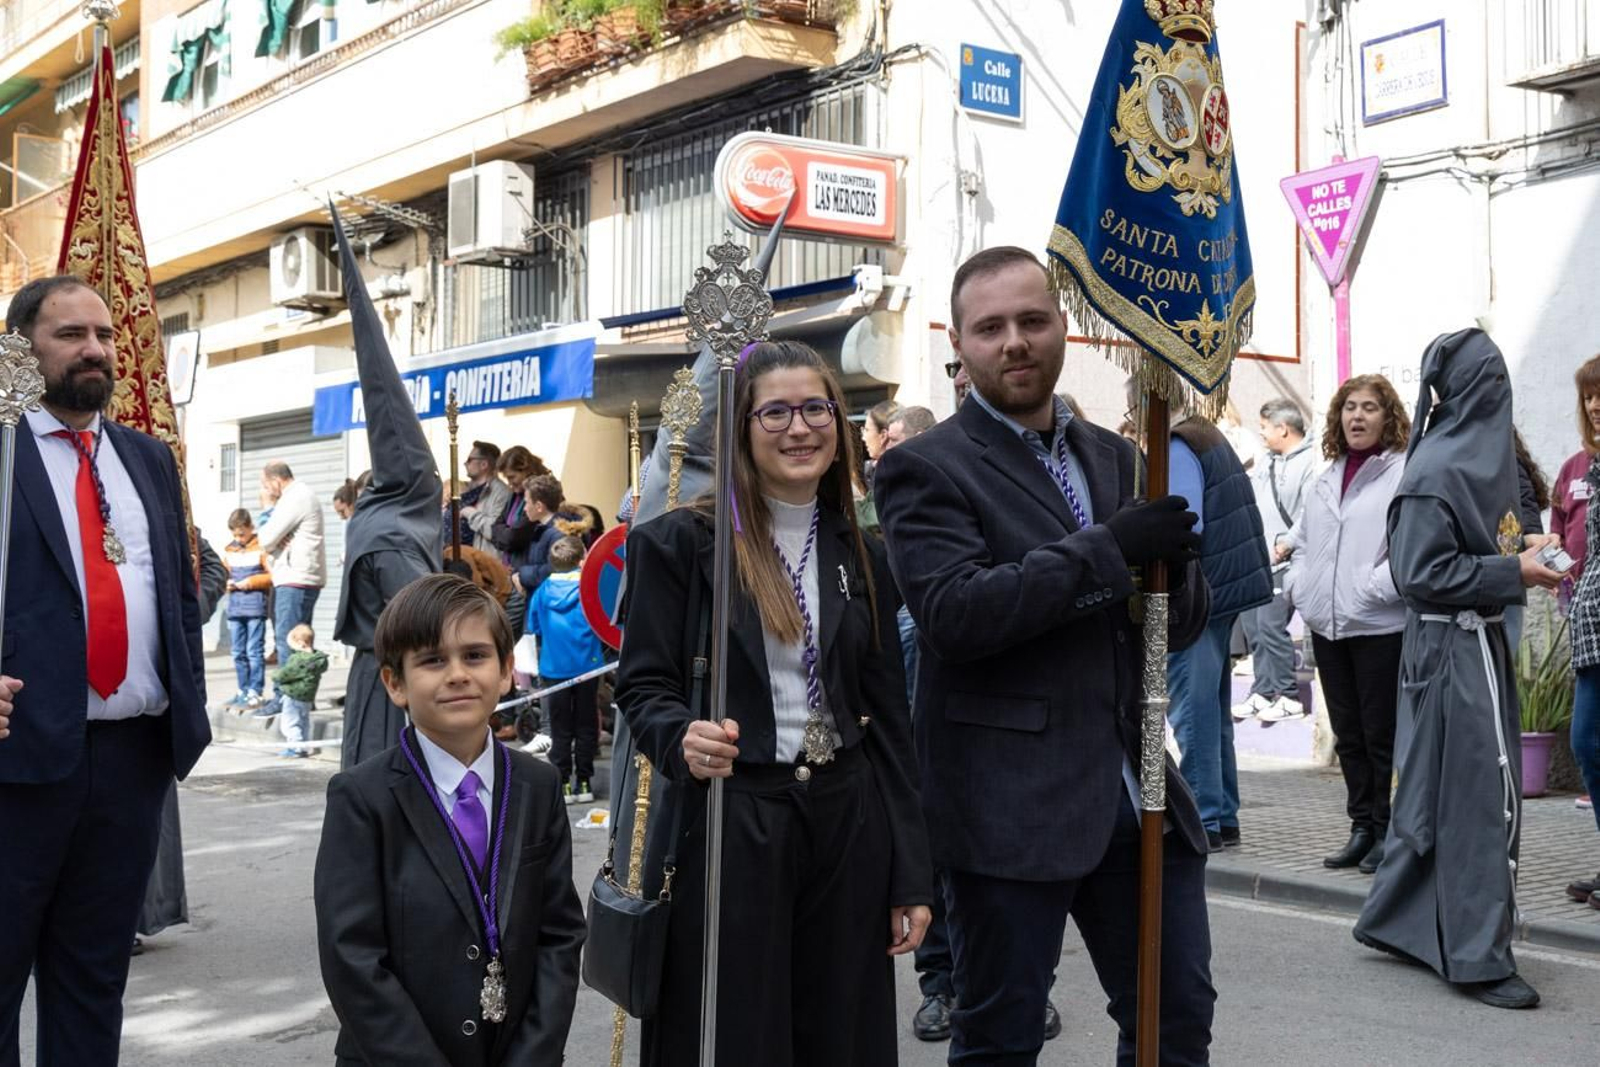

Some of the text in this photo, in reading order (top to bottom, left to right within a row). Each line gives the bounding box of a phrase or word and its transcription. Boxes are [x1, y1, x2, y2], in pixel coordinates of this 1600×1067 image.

[984, 60, 1011, 78] Calle
[971, 81, 1010, 106] LUCENA
[815, 183, 876, 217] LAS MERCEDES
[1312, 180, 1346, 200] NO TE
[1308, 196, 1351, 217] CALLES
[1101, 209, 1179, 258] SANTA
[1101, 247, 1202, 293] PATRONA
